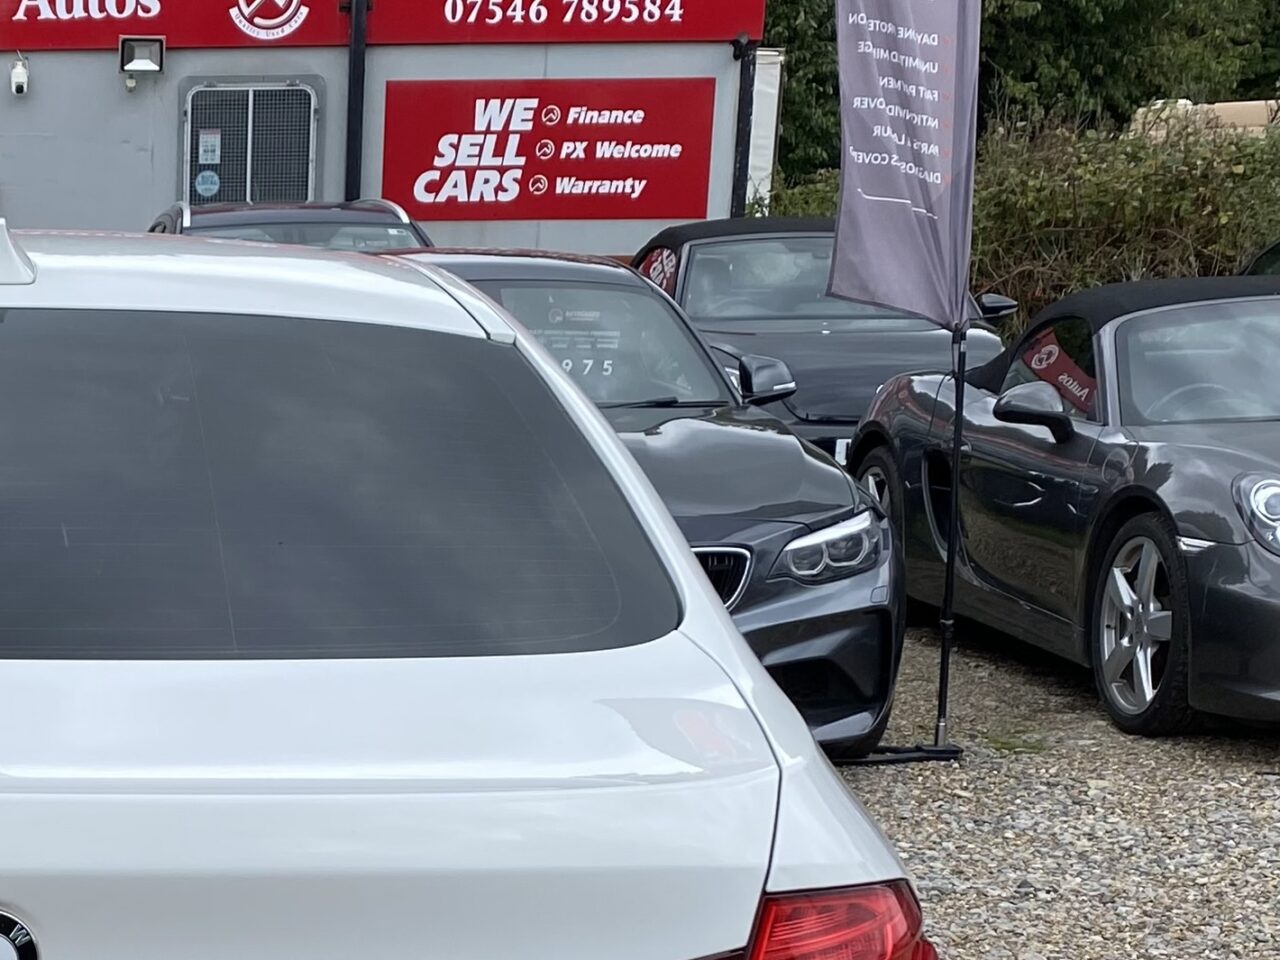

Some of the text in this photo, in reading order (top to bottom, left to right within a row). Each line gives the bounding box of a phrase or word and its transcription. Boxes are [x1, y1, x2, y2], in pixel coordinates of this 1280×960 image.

[444, 0, 684, 23] 07546 789584
[474, 98, 539, 131] WE
[566, 107, 645, 125] Finance
[433, 133, 526, 167] SELL
[560, 141, 682, 159] PX Welcome
[413, 168, 522, 203] CARS
[555, 177, 647, 199] Warranty
